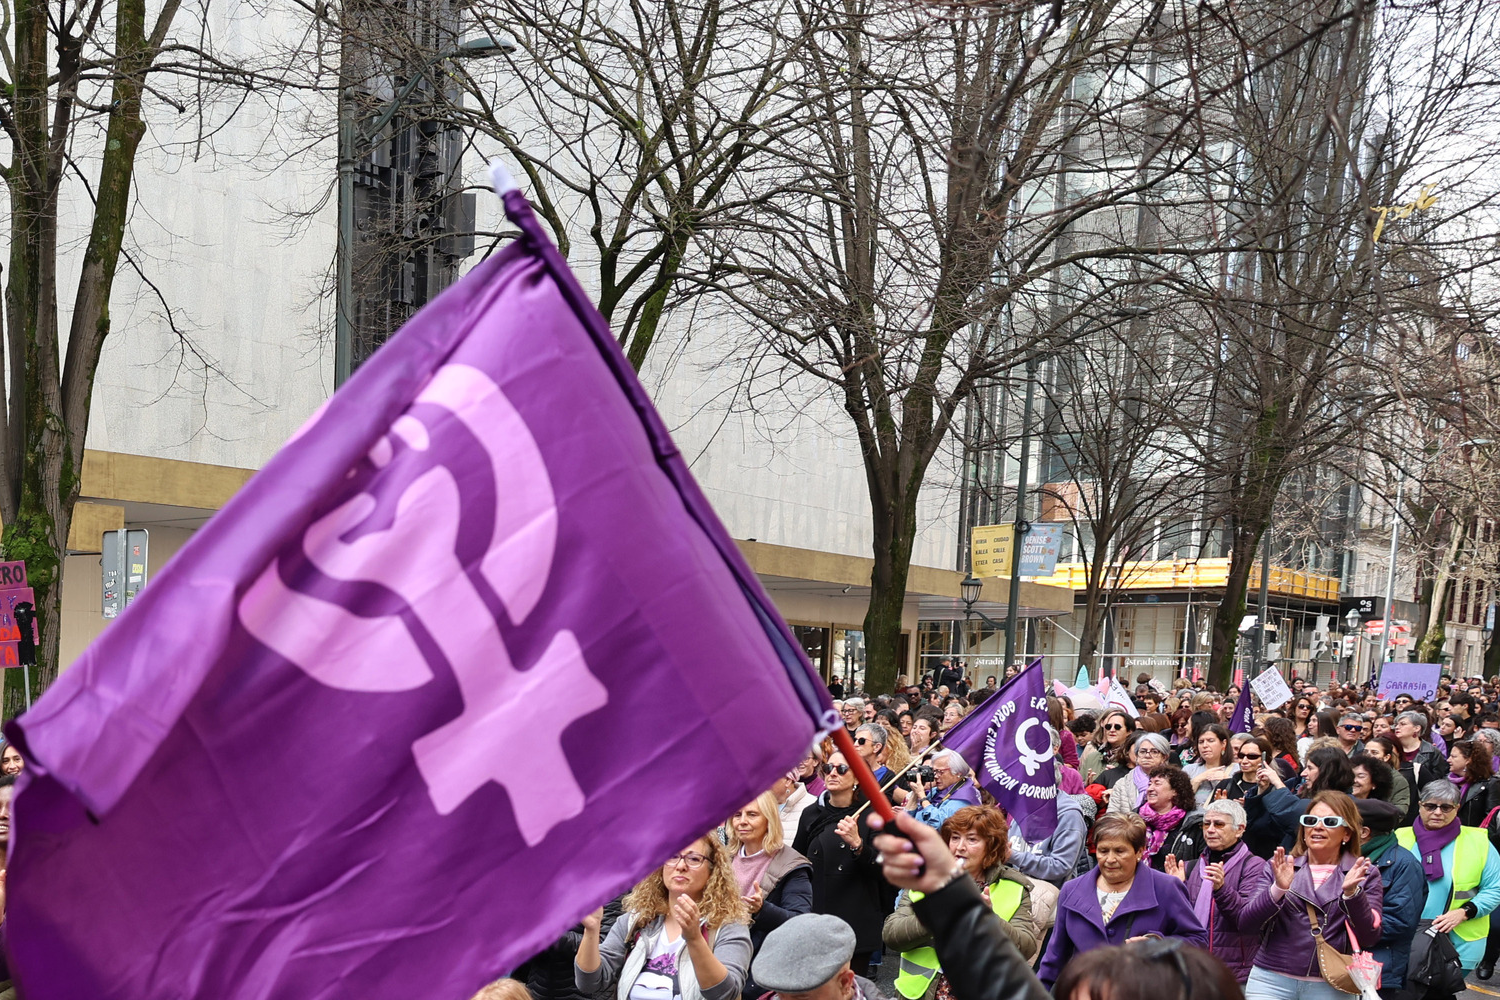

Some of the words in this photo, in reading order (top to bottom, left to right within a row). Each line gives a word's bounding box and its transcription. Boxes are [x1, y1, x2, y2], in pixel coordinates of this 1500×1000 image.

[1024, 535, 1047, 544] DENISE
[1022, 545, 1044, 554] SCOTT
[1021, 555, 1045, 563] BROWN
[6, 595, 17, 611] Y
[1125, 657, 1180, 668] stradivarius
[990, 700, 1017, 728] GORA
[983, 727, 1020, 791] EMAKUMEON
